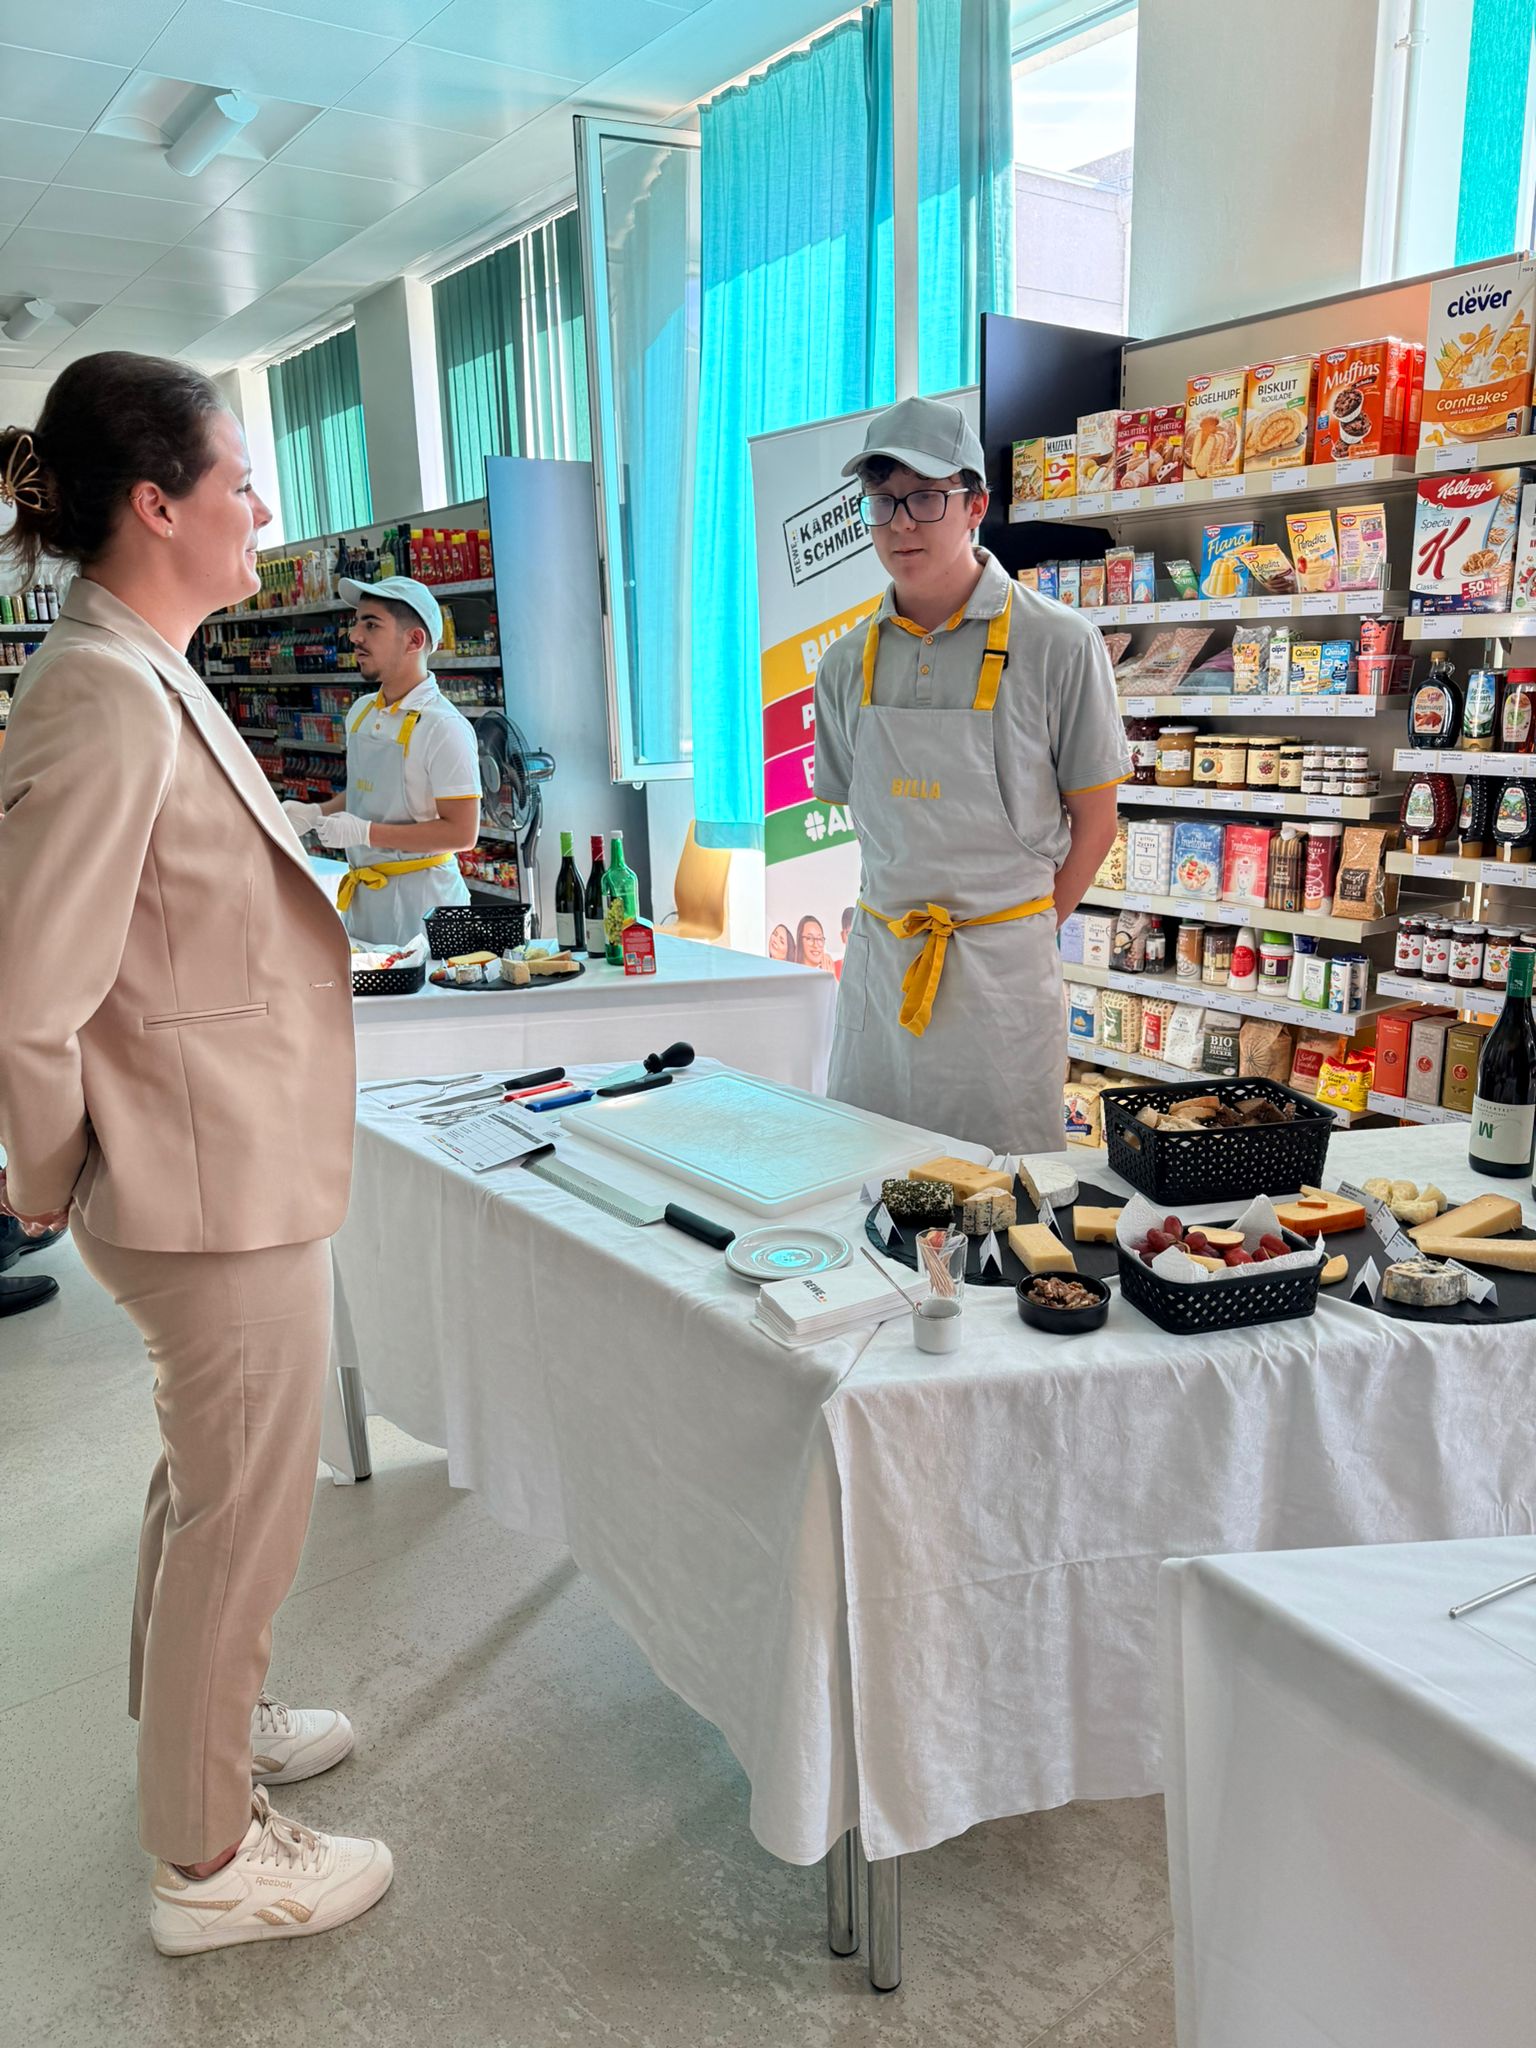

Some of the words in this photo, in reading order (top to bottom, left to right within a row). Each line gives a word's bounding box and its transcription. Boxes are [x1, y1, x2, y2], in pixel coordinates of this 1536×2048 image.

[1447, 289, 1512, 318] clever
[1323, 360, 1380, 394] Muffins
[1257, 379, 1298, 396] BISKUIT
[1188, 388, 1241, 407] GUGELHUPF
[1261, 392, 1293, 403] ROULADE
[1436, 390, 1509, 412] Cornflakes
[1437, 478, 1495, 500] Kellogg's
[1421, 517, 1454, 530] Special
[1417, 516, 1471, 580] K
[1416, 583, 1439, 591] Classic
[891, 777, 941, 800] BILLA
[1210, 1035, 1233, 1048] BIO
[1209, 1049, 1233, 1057] ZUCKER
[802, 1279, 826, 1297] REWE
[255, 1876, 293, 1889] Reebok
